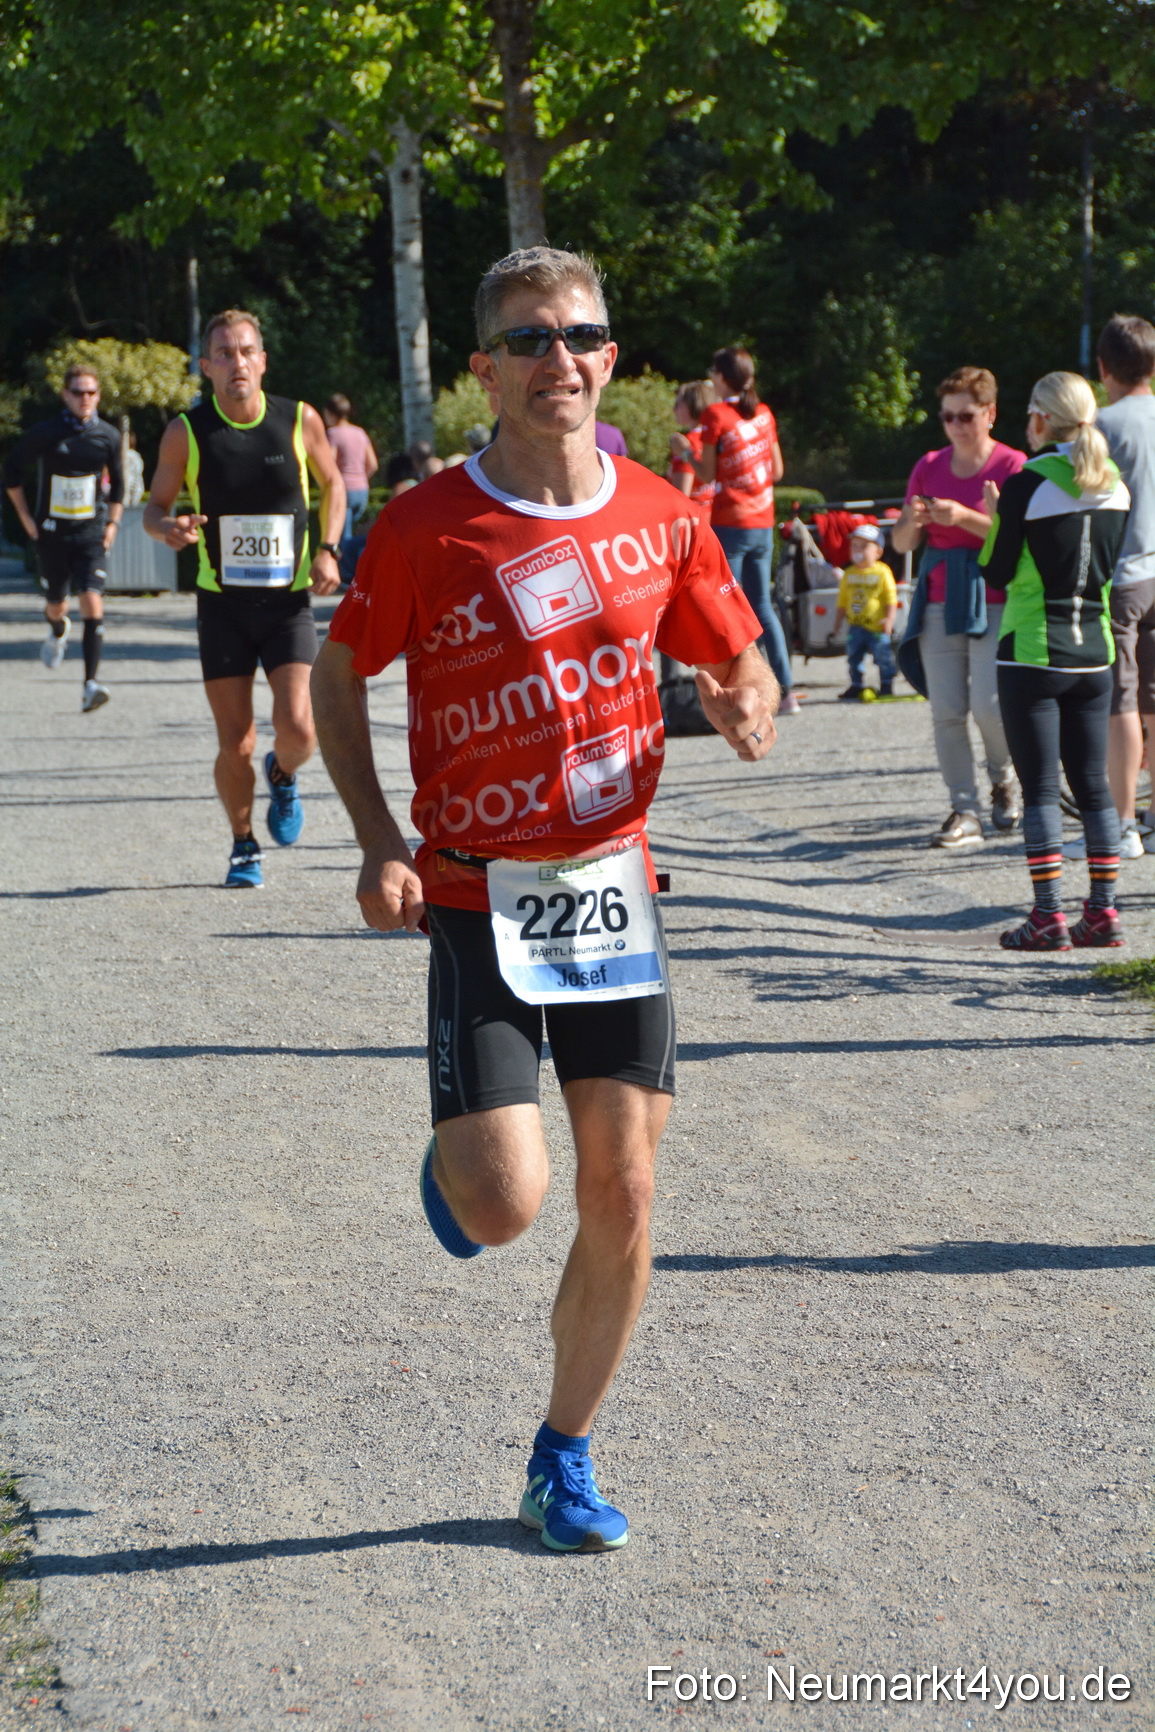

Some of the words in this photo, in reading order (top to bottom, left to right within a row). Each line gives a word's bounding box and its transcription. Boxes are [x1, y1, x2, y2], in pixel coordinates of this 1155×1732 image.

[232, 535, 280, 557] 2301
[503, 544, 575, 585] raumbox
[446, 641, 504, 672] outdoor
[431, 630, 654, 751] raumbox
[514, 717, 587, 747] wohnen
[600, 682, 658, 716] outdoor
[566, 735, 626, 770] raumbox
[516, 886, 629, 941] 2226
[531, 947, 567, 959] PARTL
[568, 943, 612, 956] Neumarkt
[557, 964, 608, 988] Josef
[437, 1018, 452, 1093] 2XU
